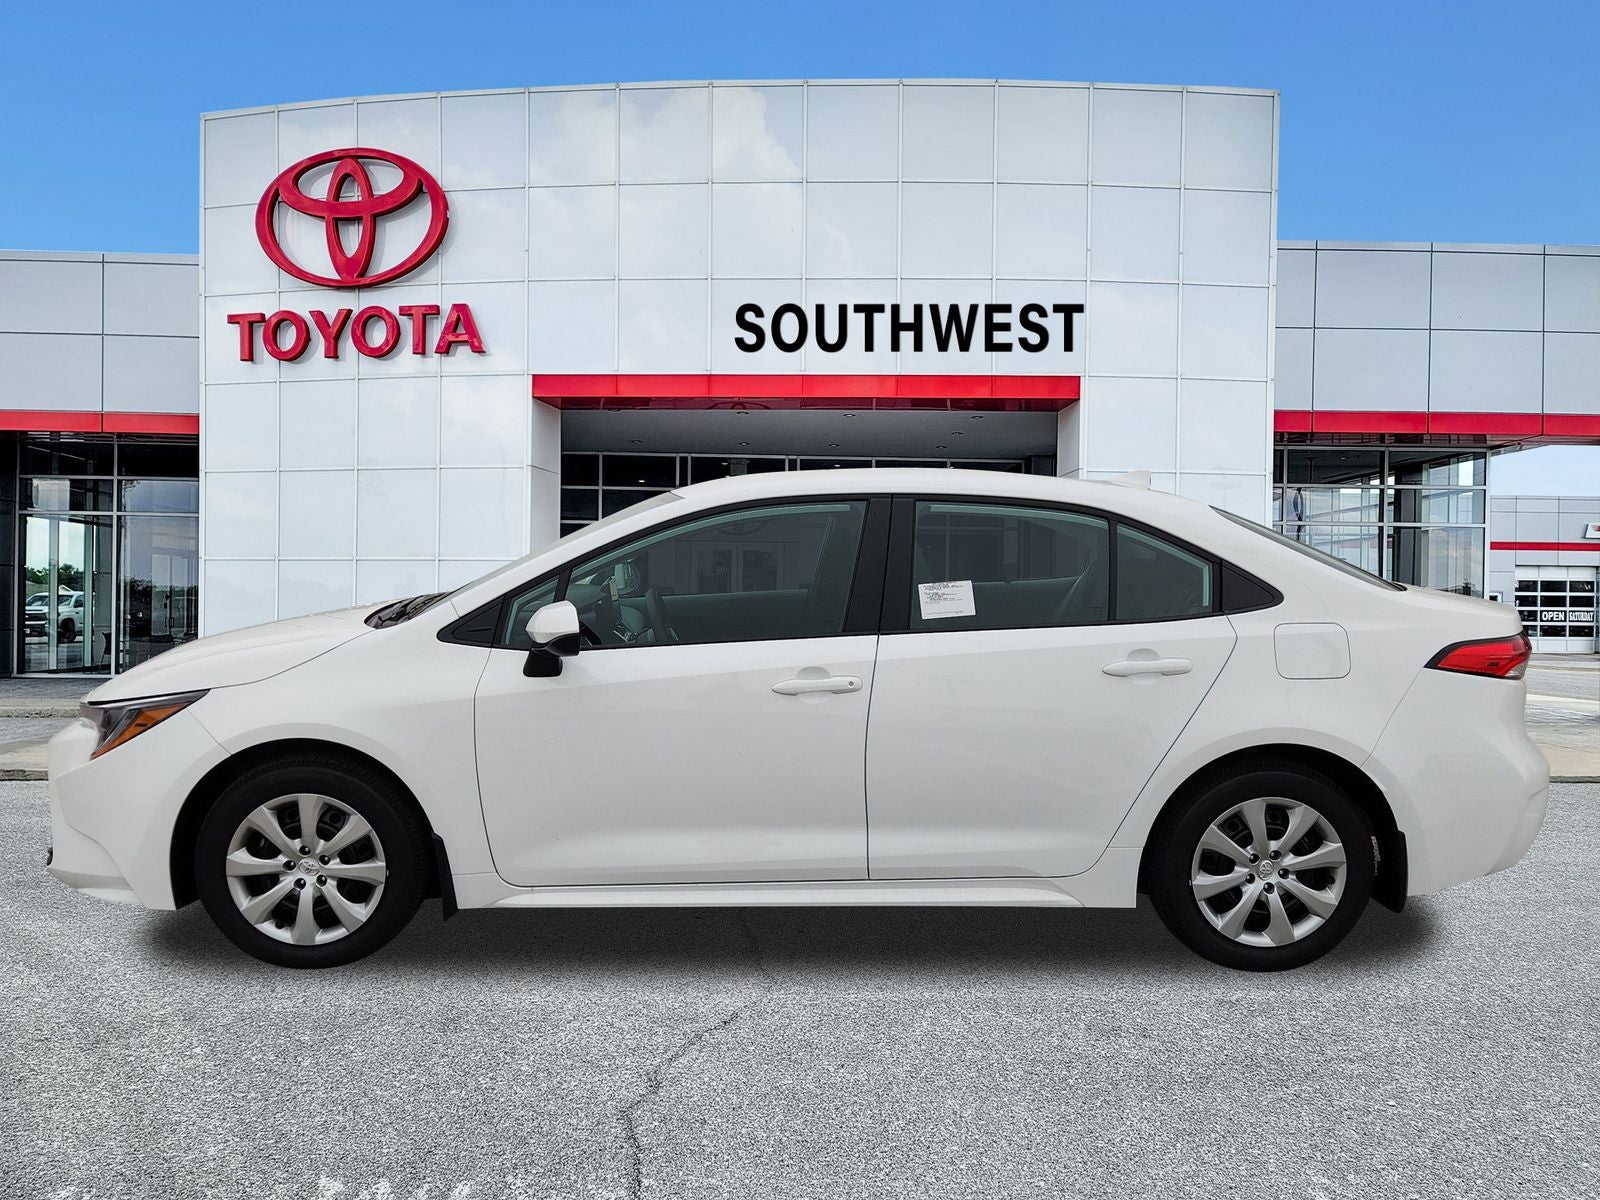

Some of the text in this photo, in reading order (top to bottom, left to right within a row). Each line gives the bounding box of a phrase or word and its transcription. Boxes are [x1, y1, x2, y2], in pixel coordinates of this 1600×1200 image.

[227, 303, 486, 362] TOYOTA
[734, 303, 1085, 353] SOUTHWEST
[1541, 611, 1594, 621] OPEN SATURDAY
